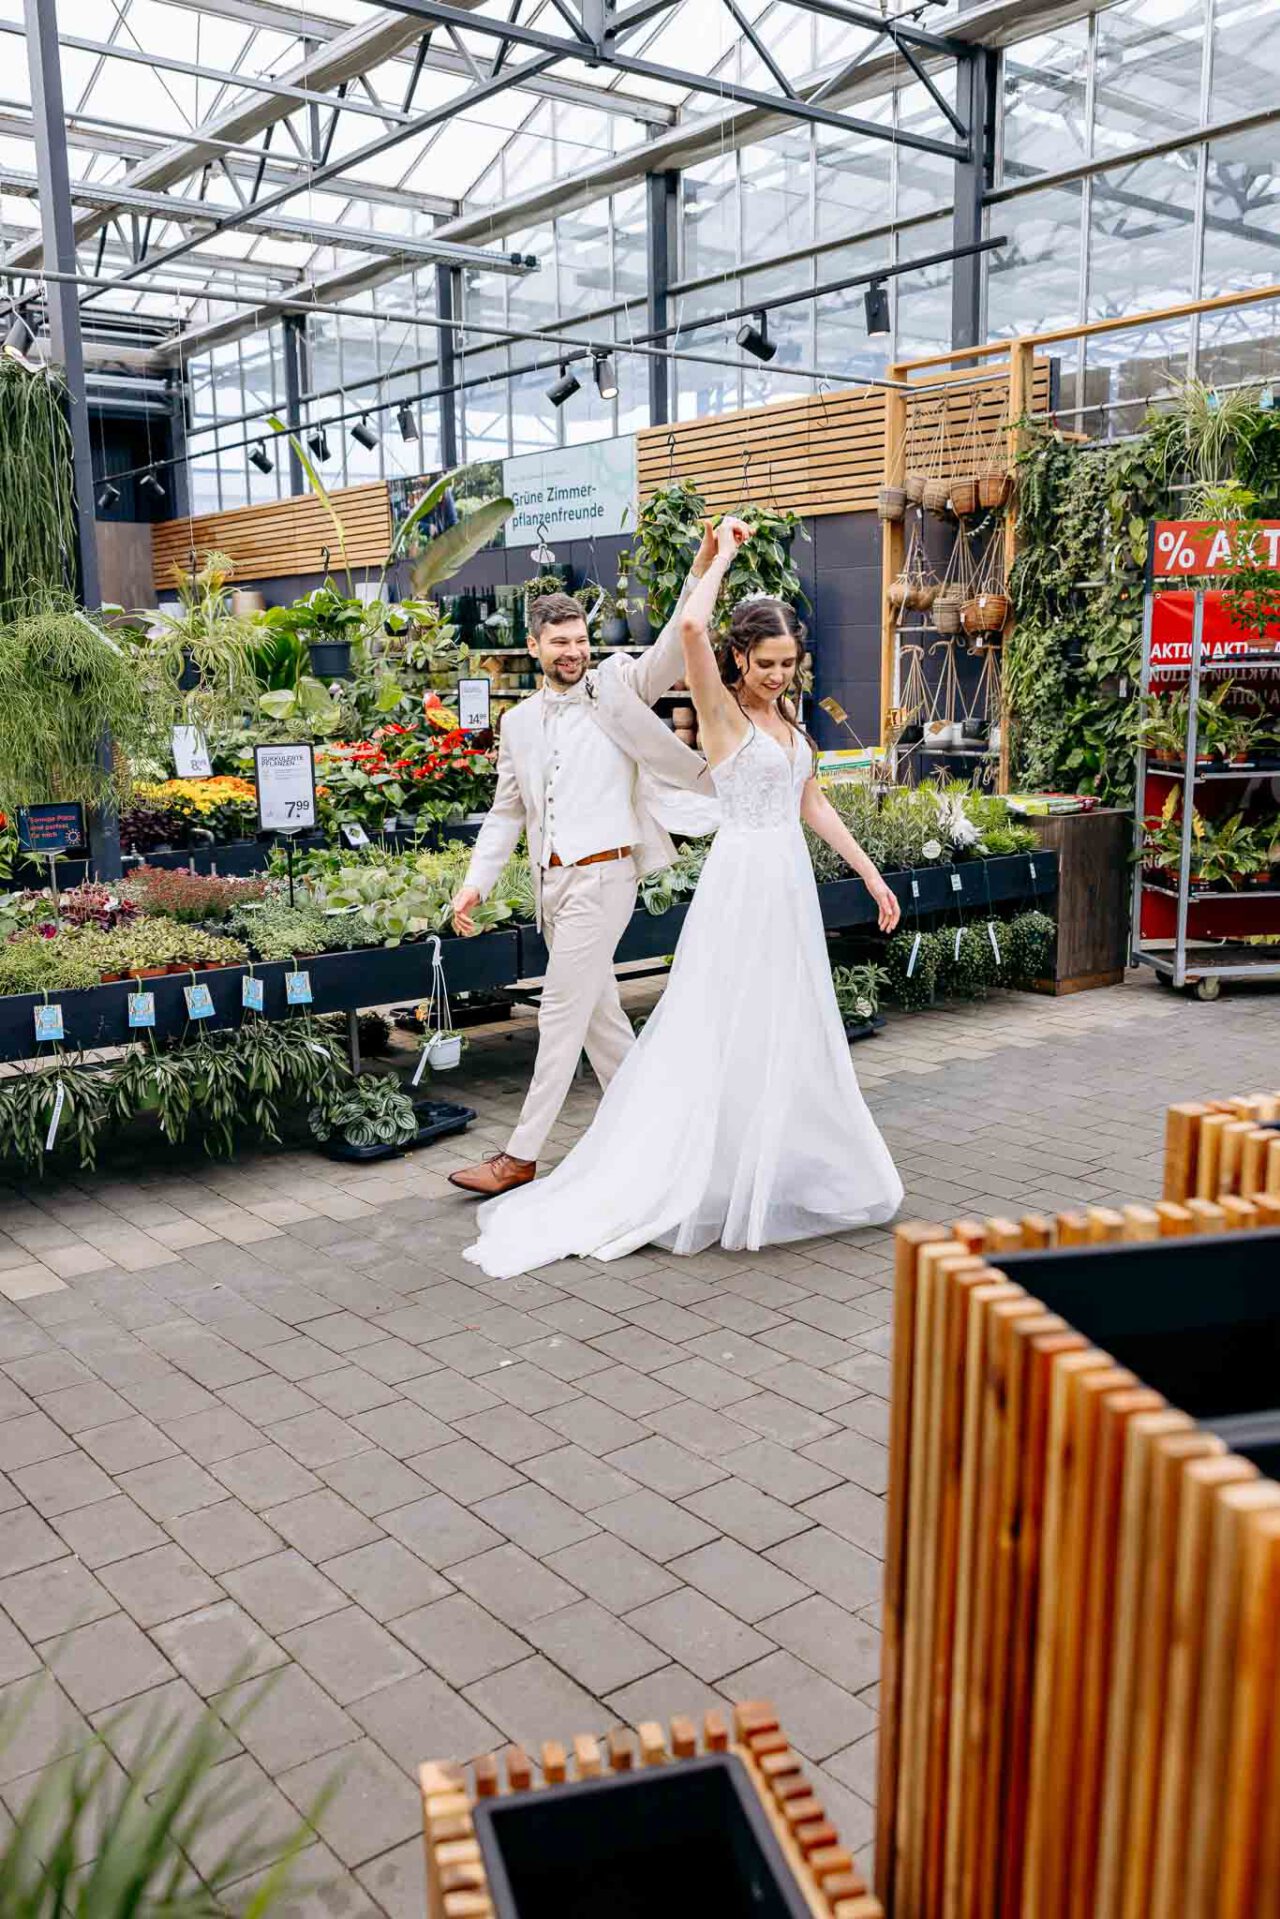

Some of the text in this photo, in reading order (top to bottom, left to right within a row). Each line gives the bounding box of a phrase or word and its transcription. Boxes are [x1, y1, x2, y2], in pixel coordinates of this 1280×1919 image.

[512, 485, 597, 506] Grüne Zimmer-
[512, 503, 605, 531] pflanzenfreunde
[1158, 530, 1195, 570] %
[1151, 642, 1211, 659] AKTIN
